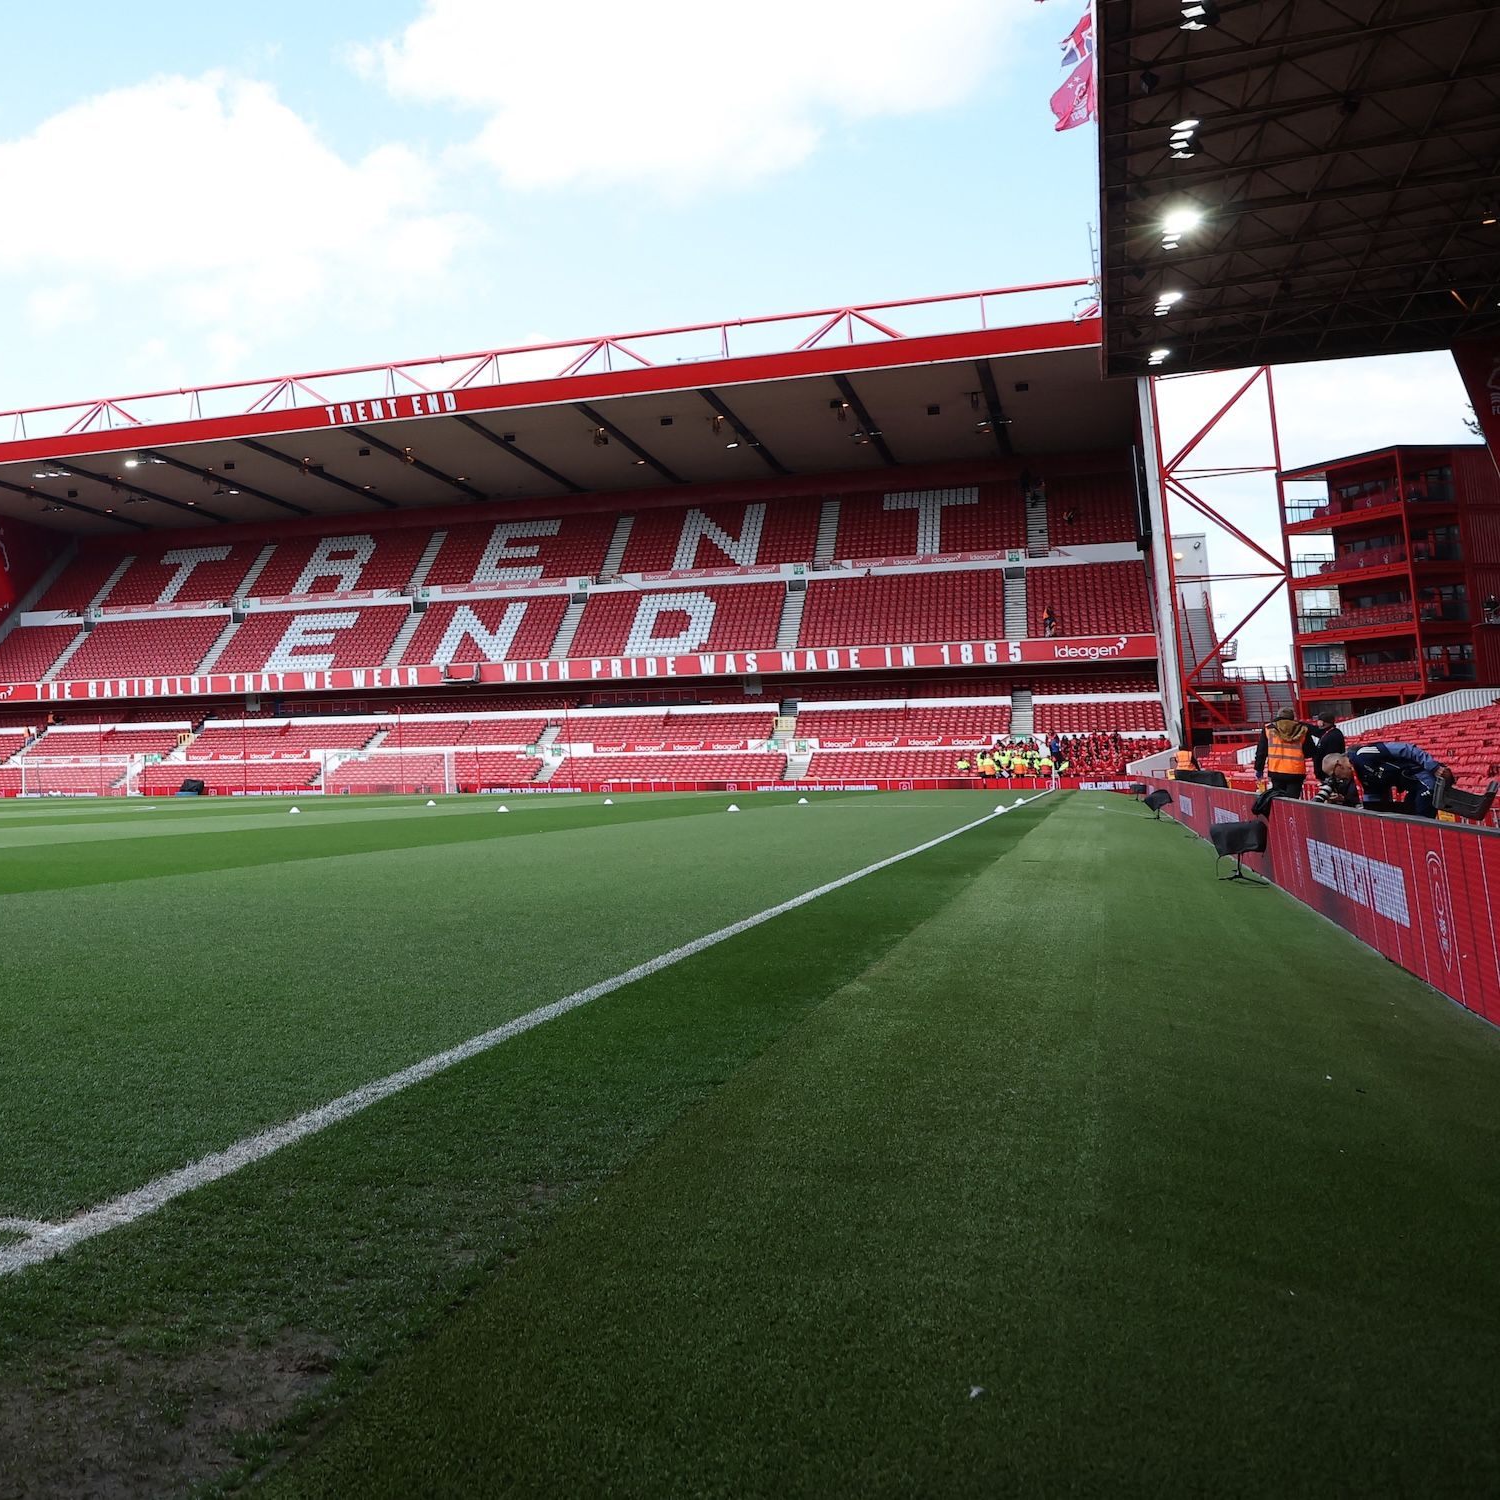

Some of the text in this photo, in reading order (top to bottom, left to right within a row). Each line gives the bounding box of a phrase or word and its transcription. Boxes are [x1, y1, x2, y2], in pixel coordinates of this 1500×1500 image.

[325, 392, 457, 425] TRENT END
[156, 487, 978, 604] TRENT
[261, 592, 717, 673] END
[1054, 644, 1118, 660] Ideagen
[36, 641, 1023, 700] THE GARIBALDI THAT WE WEAR WITH PRIDE WAS MADE IN 1865
[1079, 782, 1114, 790] WELCOME
